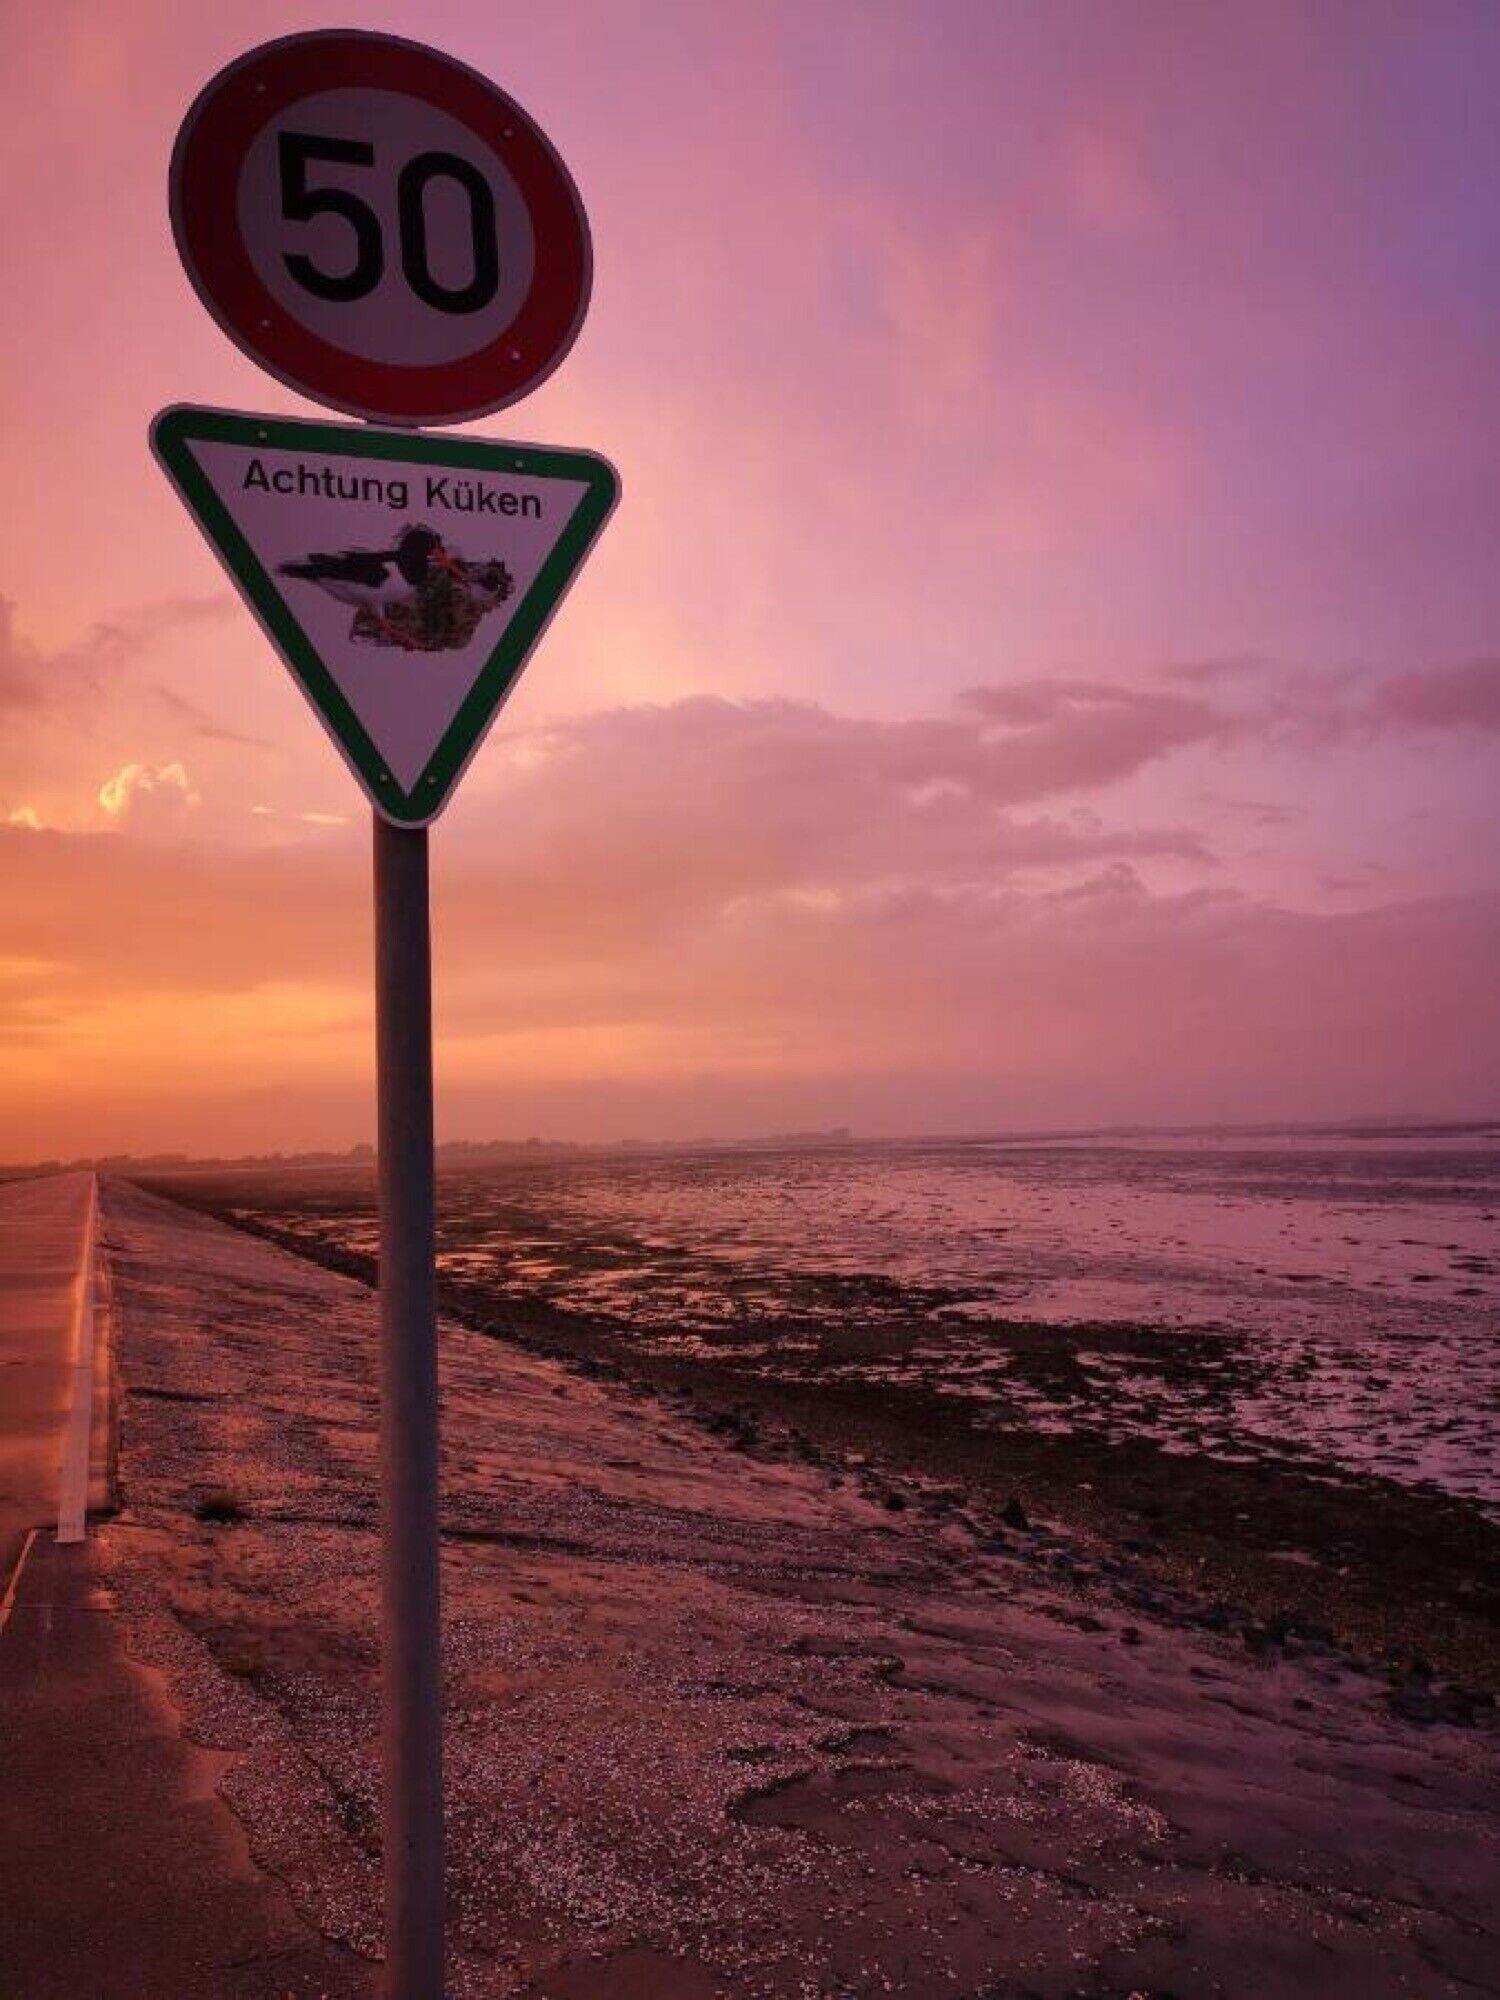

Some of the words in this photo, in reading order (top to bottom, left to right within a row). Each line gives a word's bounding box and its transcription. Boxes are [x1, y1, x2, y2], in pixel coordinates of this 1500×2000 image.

[277, 130, 501, 316] 50
[241, 458, 410, 511] Achtung
[425, 475, 544, 520] Küken
